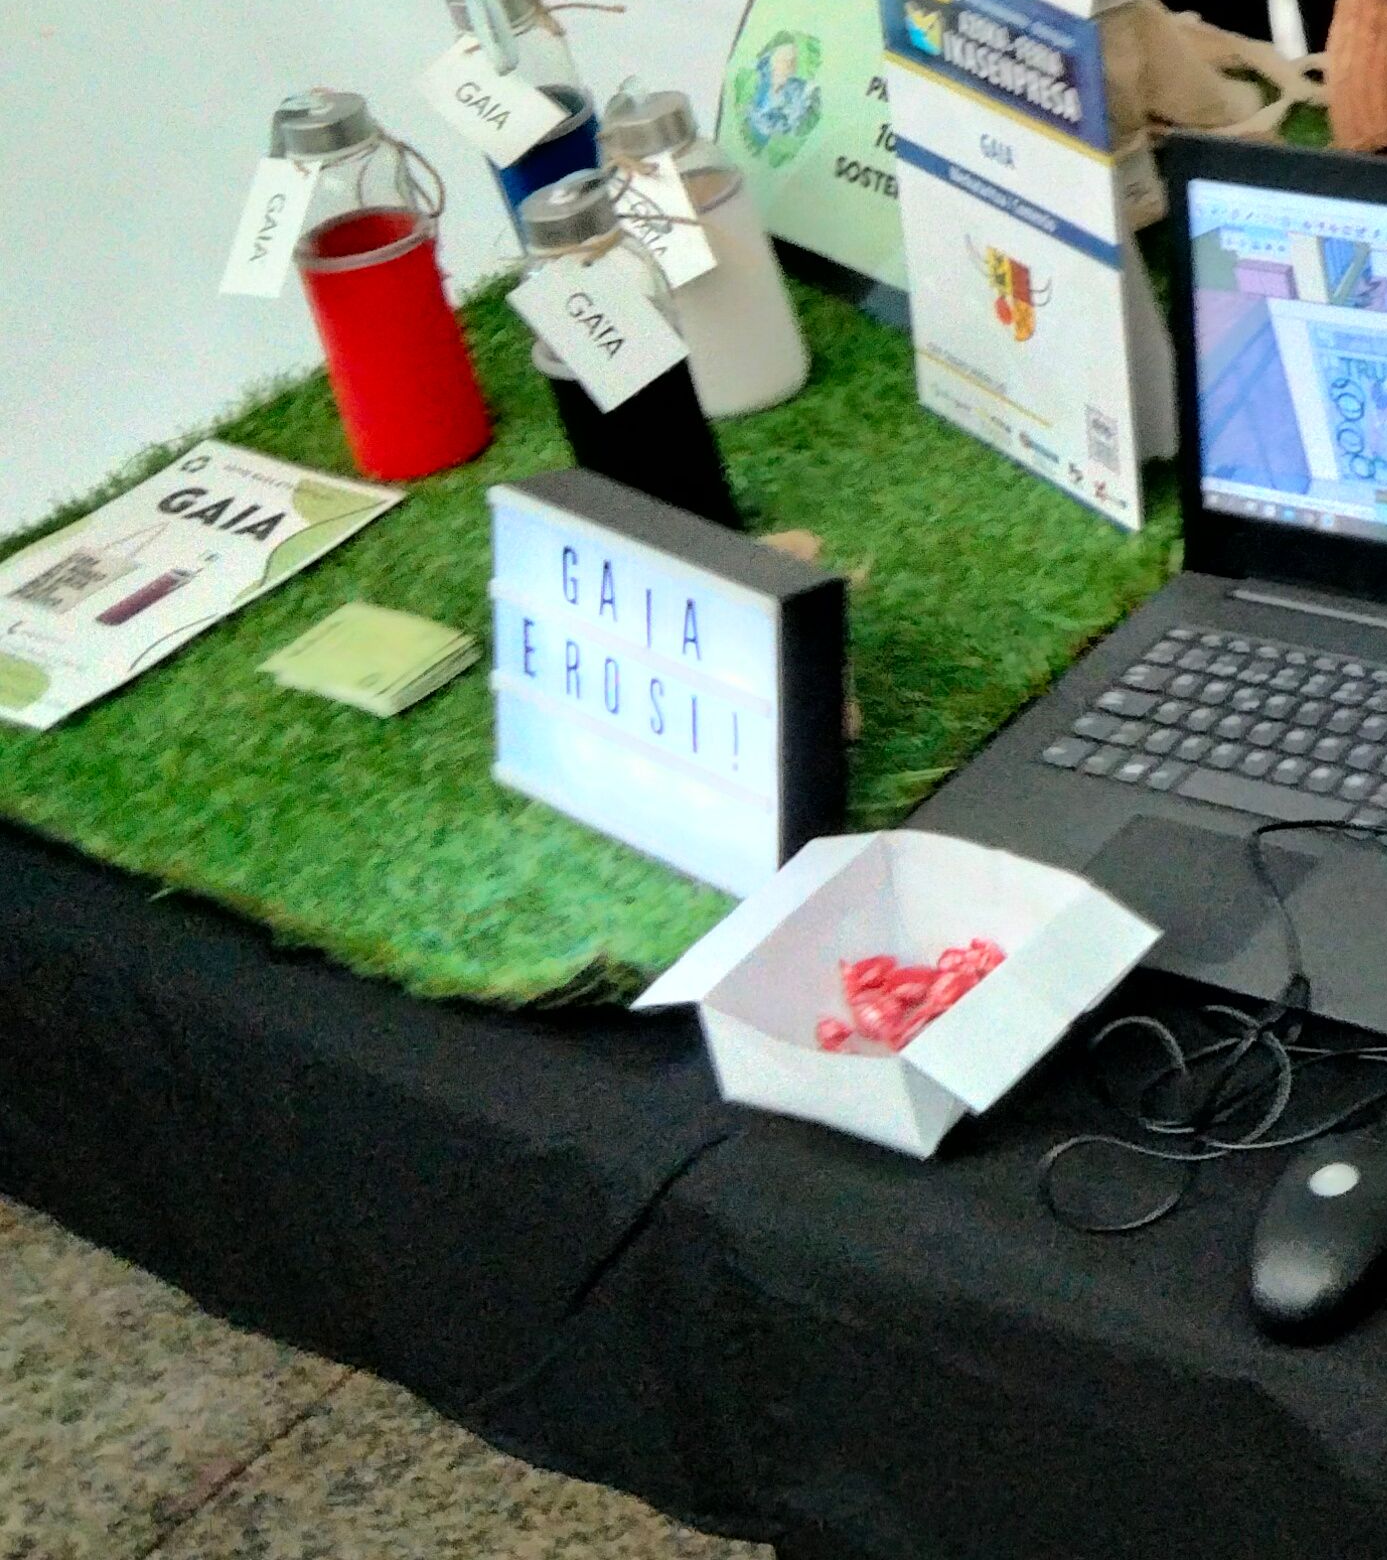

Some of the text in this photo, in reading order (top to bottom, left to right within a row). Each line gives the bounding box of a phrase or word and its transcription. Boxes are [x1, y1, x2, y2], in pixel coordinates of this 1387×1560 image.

[455, 80, 514, 131] GAIA
[249, 192, 284, 262] GAIA
[565, 291, 627, 361] GAIA
[156, 486, 287, 542] GAIA
[562, 545, 702, 662] GAIA
[522, 616, 740, 772] EROSI!
